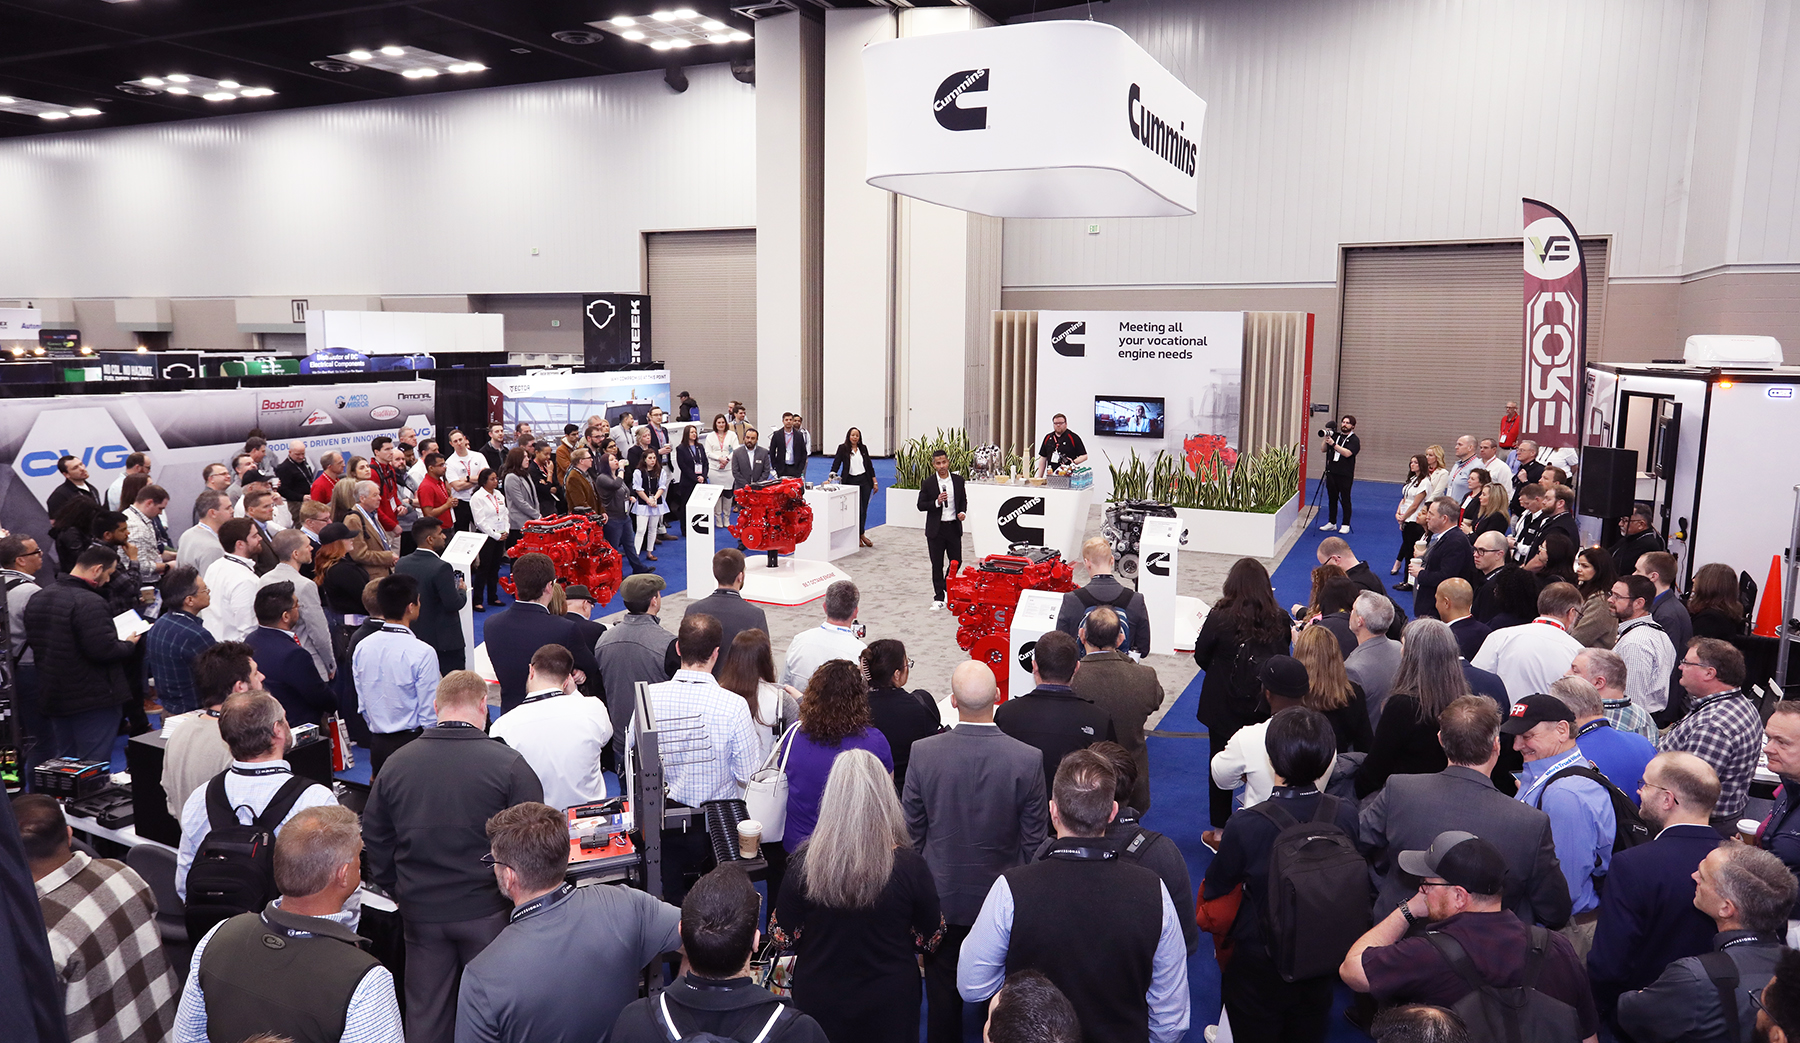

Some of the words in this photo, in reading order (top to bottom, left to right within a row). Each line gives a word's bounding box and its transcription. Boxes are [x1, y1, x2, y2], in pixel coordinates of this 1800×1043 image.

[933, 69, 985, 112] Cummins
[1128, 82, 1197, 178] Cummins
[1052, 321, 1083, 344] Cummins
[1119, 321, 1165, 334] Meeting
[1168, 322, 1183, 332] all
[1118, 337, 1145, 347] your
[1147, 336, 1207, 346] vocational
[334, 360, 365, 368] Components
[1118, 350, 1155, 360] engine
[1158, 350, 1193, 359] needs
[1528, 291, 1574, 434] CORE
[261, 399, 304, 410] Bostrom
[267, 441, 308, 452] RODUS
[309, 438, 339, 448] DRIVEN
[341, 436, 351, 445] BY
[352, 432, 397, 444] INNOVTION
[413, 428, 431, 436] VG
[21, 444, 130, 478] CVG
[997, 497, 1042, 526] Cummins
